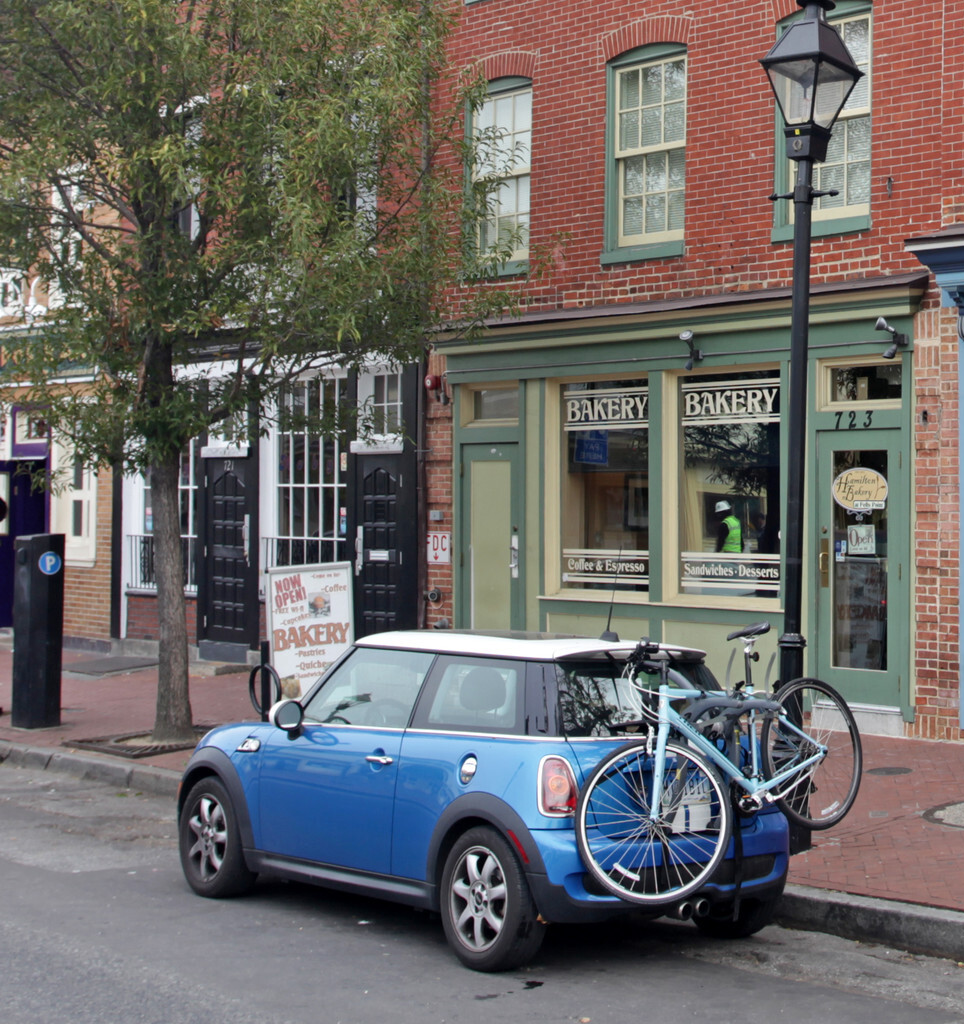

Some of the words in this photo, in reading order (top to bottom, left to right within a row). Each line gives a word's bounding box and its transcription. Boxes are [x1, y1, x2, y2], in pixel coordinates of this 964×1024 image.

[566, 396, 648, 422] BAKERY
[684, 388, 778, 416] BAKERY
[834, 410, 874, 430] 723
[223, 460, 235, 471] 721
[836, 472, 876, 493] Hamilton
[845, 484, 872, 502] Bakery
[849, 529, 873, 547] Open
[567, 558, 594, 571] Coffee
[595, 561, 603, 571] &
[605, 559, 645, 573] Espresso
[684, 563, 734, 576] Sandwiches
[738, 564, 779, 578] Desserts
[274, 574, 302, 593] NOW
[274, 586, 308, 609] OPEN!
[272, 621, 350, 651] BAKERY
